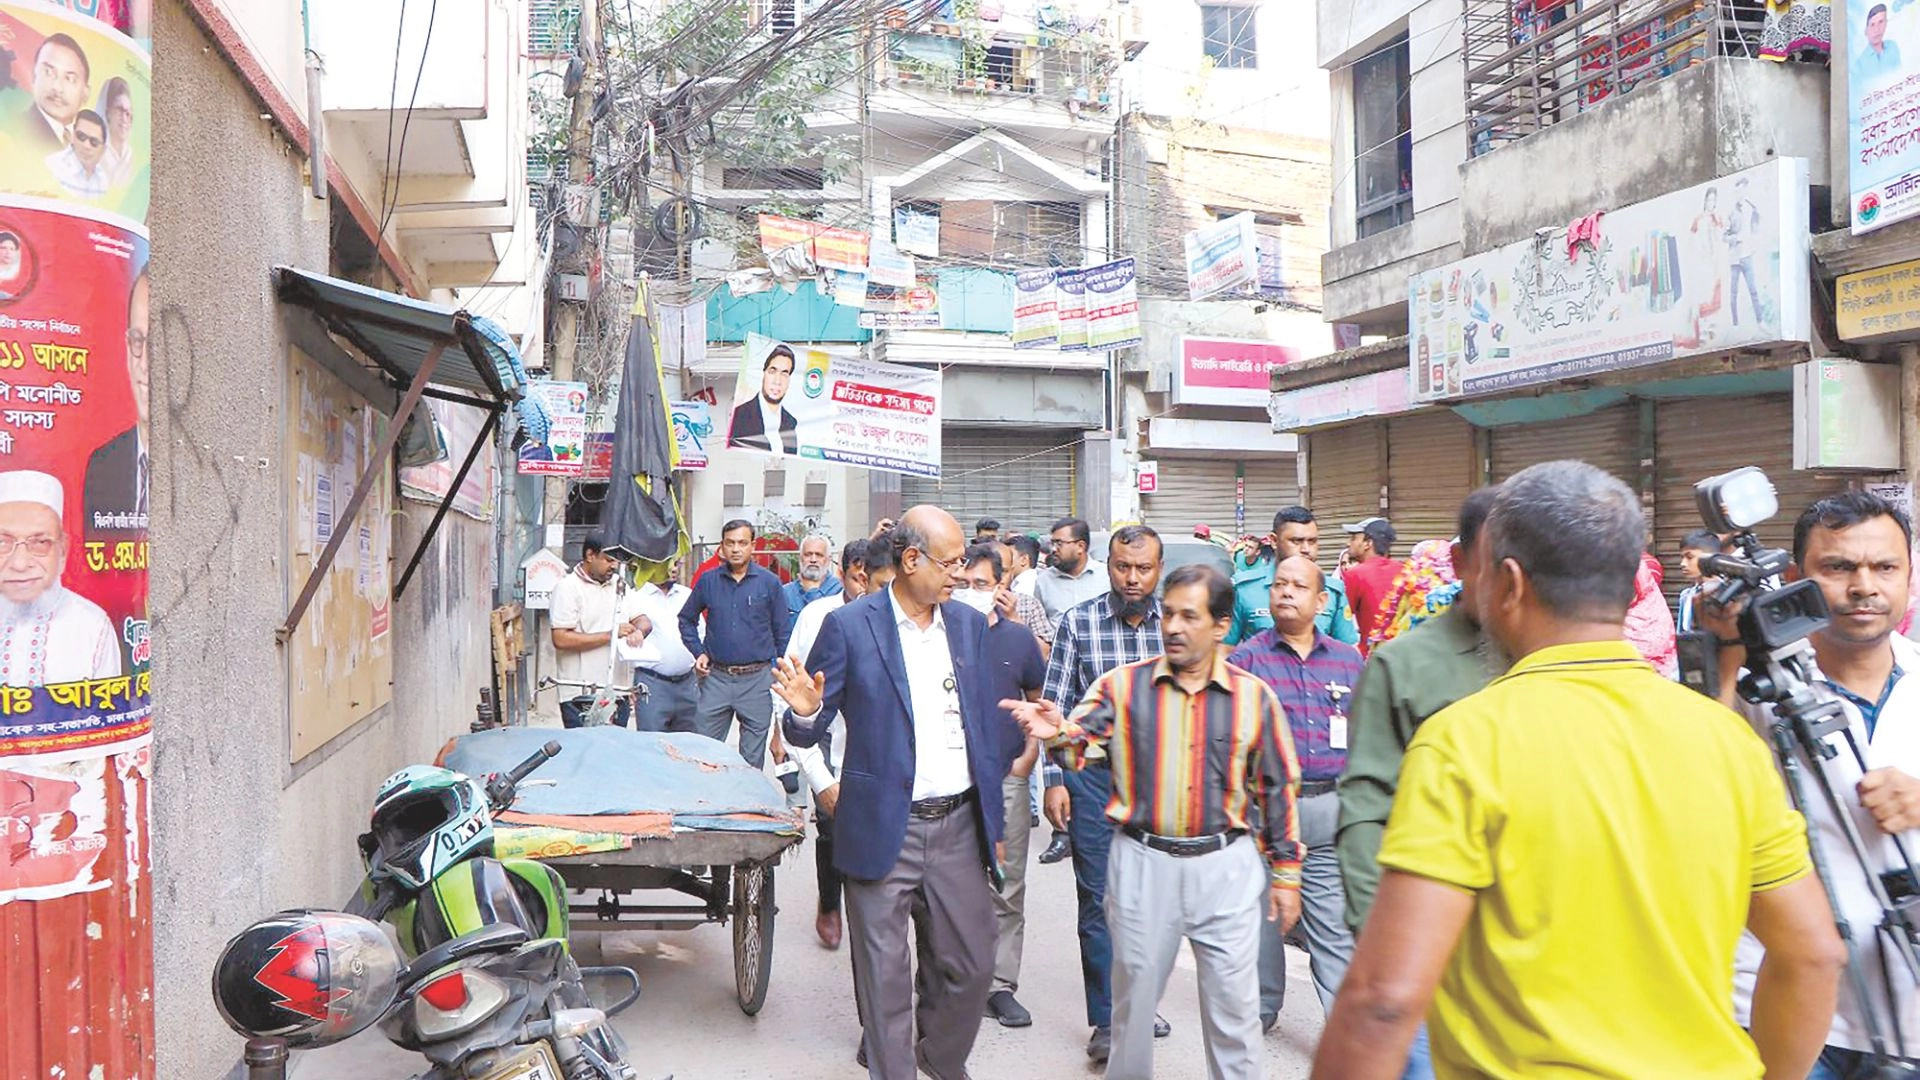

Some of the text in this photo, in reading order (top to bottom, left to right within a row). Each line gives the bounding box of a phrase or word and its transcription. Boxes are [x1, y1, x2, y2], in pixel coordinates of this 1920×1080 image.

[31, 343, 89, 374] আসনে
[14, 381, 82, 405] মনোনীত
[835, 384, 882, 405] অভিভাবক
[4, 409, 55, 429] সদস্য
[44, 676, 131, 710] আবুল
